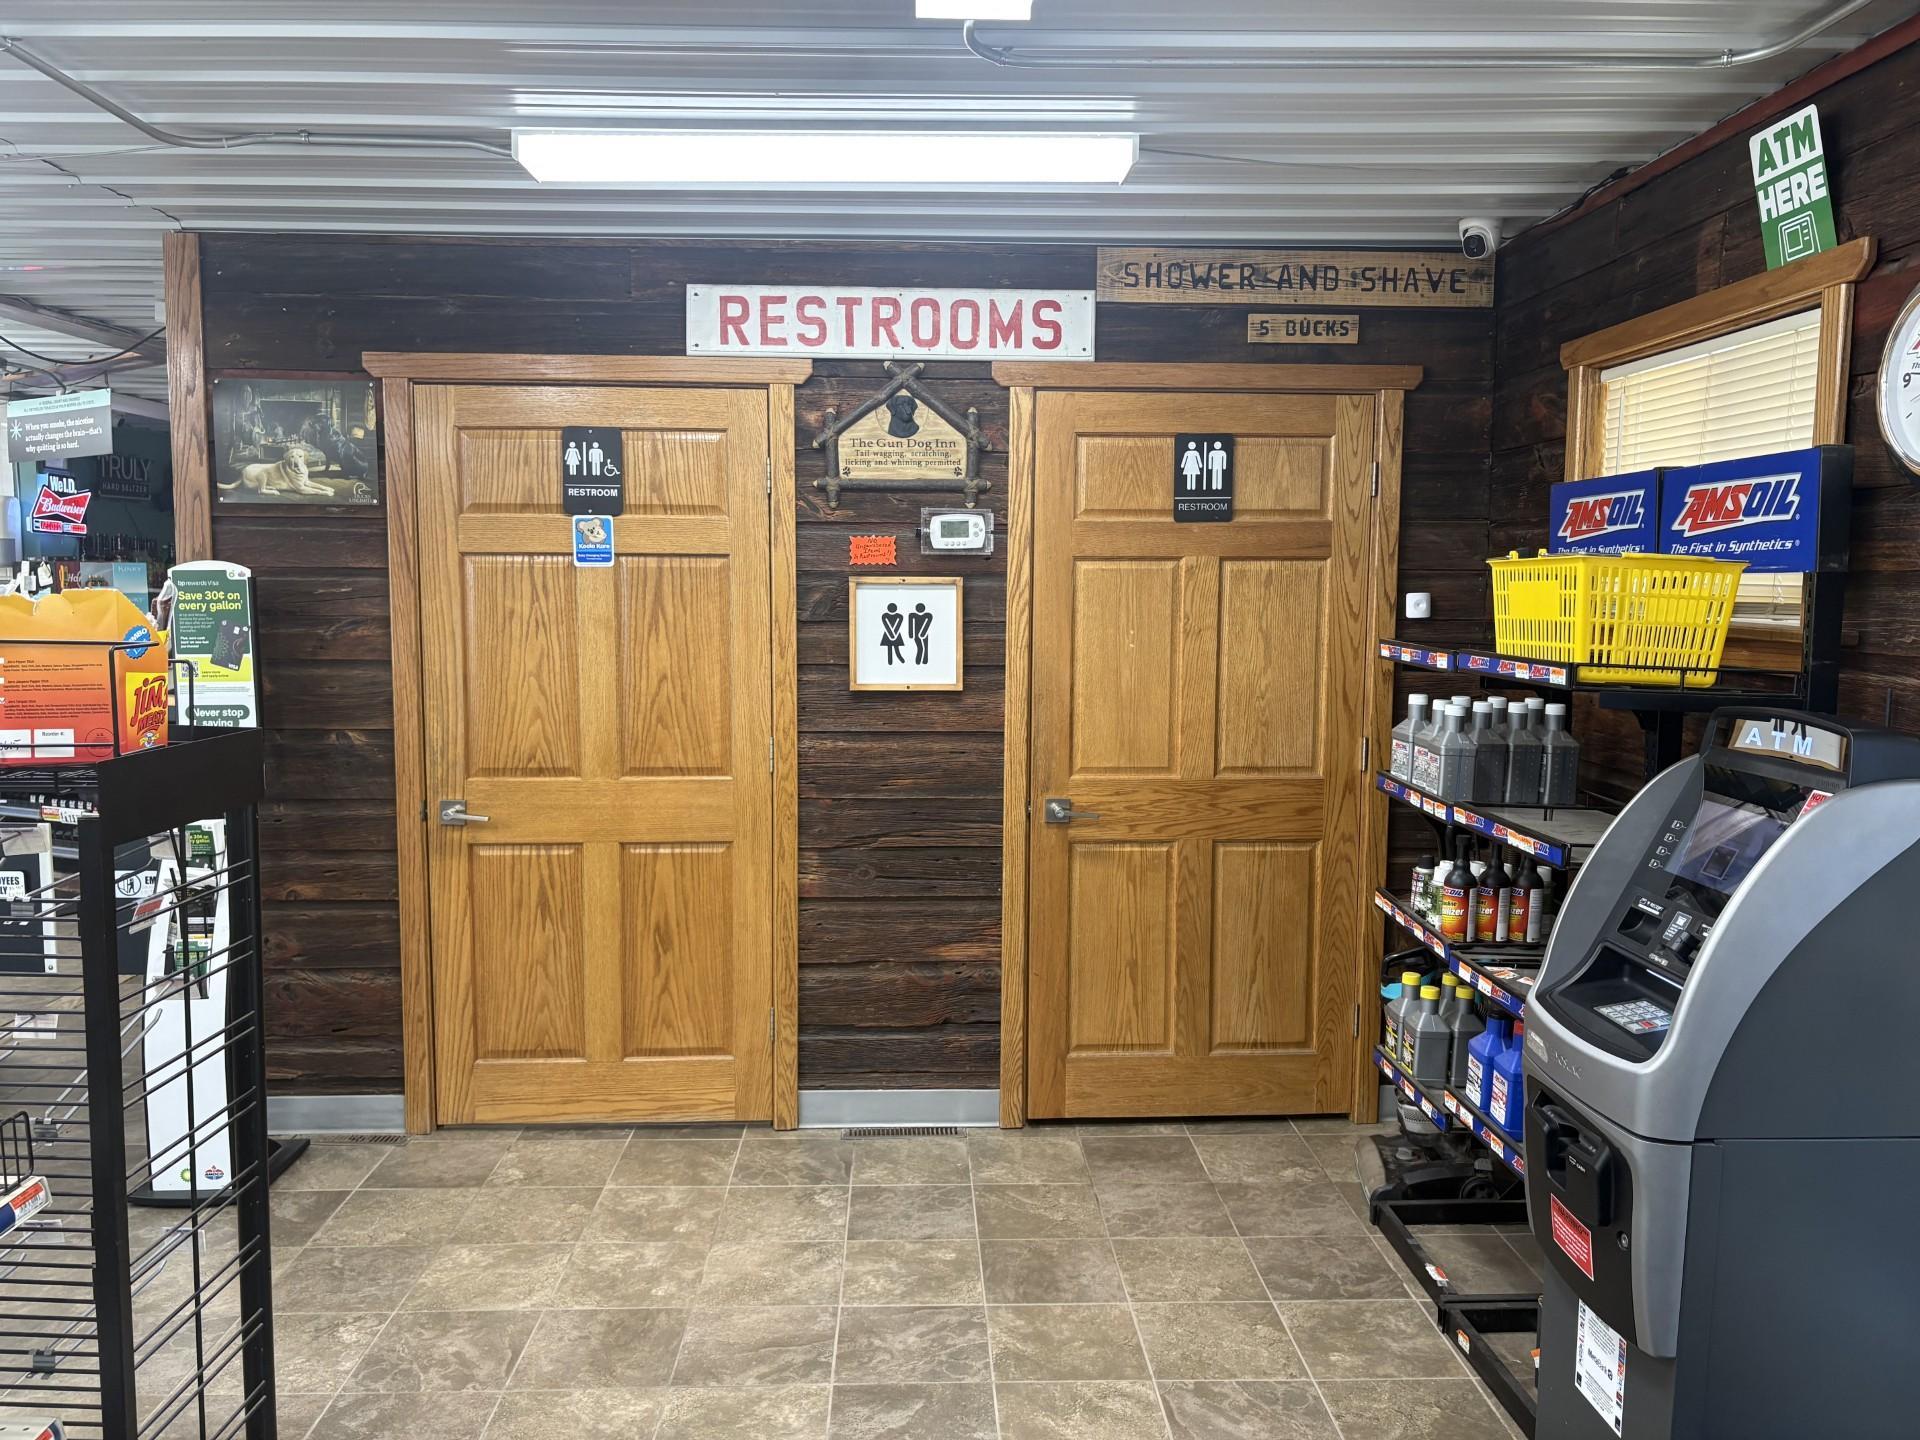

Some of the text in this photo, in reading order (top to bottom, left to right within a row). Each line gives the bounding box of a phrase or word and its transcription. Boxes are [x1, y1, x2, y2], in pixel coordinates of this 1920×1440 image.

[1758, 113, 1817, 179] ATM
[1757, 162, 1827, 223] HERE
[1124, 262, 1466, 294] SHOWER AND SHAVE
[719, 296, 1063, 350] RESTROOMS
[1259, 319, 1350, 337] 5 BUCKS
[1903, 372, 1911, 388] 9
[40, 422, 49, 431] you
[25, 432, 44, 442] actually
[45, 431, 64, 440] changes
[64, 430, 73, 438] the
[25, 445, 36, 453] why
[37, 442, 56, 453] quitting
[67, 440, 80, 449] hard.
[850, 438, 956, 451] The Gun Dog Inn
[873, 450, 907, 458] wagging,
[911, 450, 952, 458] scratching,
[97, 455, 151, 481] TRULY
[845, 459, 871, 467] licking
[890, 459, 922, 467] whining
[925, 459, 961, 467] permitted
[102, 482, 119, 490] HARD
[568, 488, 618, 497] RESTROOM
[40, 497, 85, 514] Budweiser
[1178, 502, 1228, 511] RESTROOM
[1673, 474, 1801, 535] AMSOIL
[1561, 493, 1643, 539] AMSOIL
[1598, 544, 1640, 553] Synthetics
[1670, 538, 1793, 555] The First in Synthetics
[178, 591, 240, 600] Save 30¢ on
[178, 602, 207, 612] every
[193, 708, 244, 718] Never stop
[1745, 727, 1813, 756] ATM
